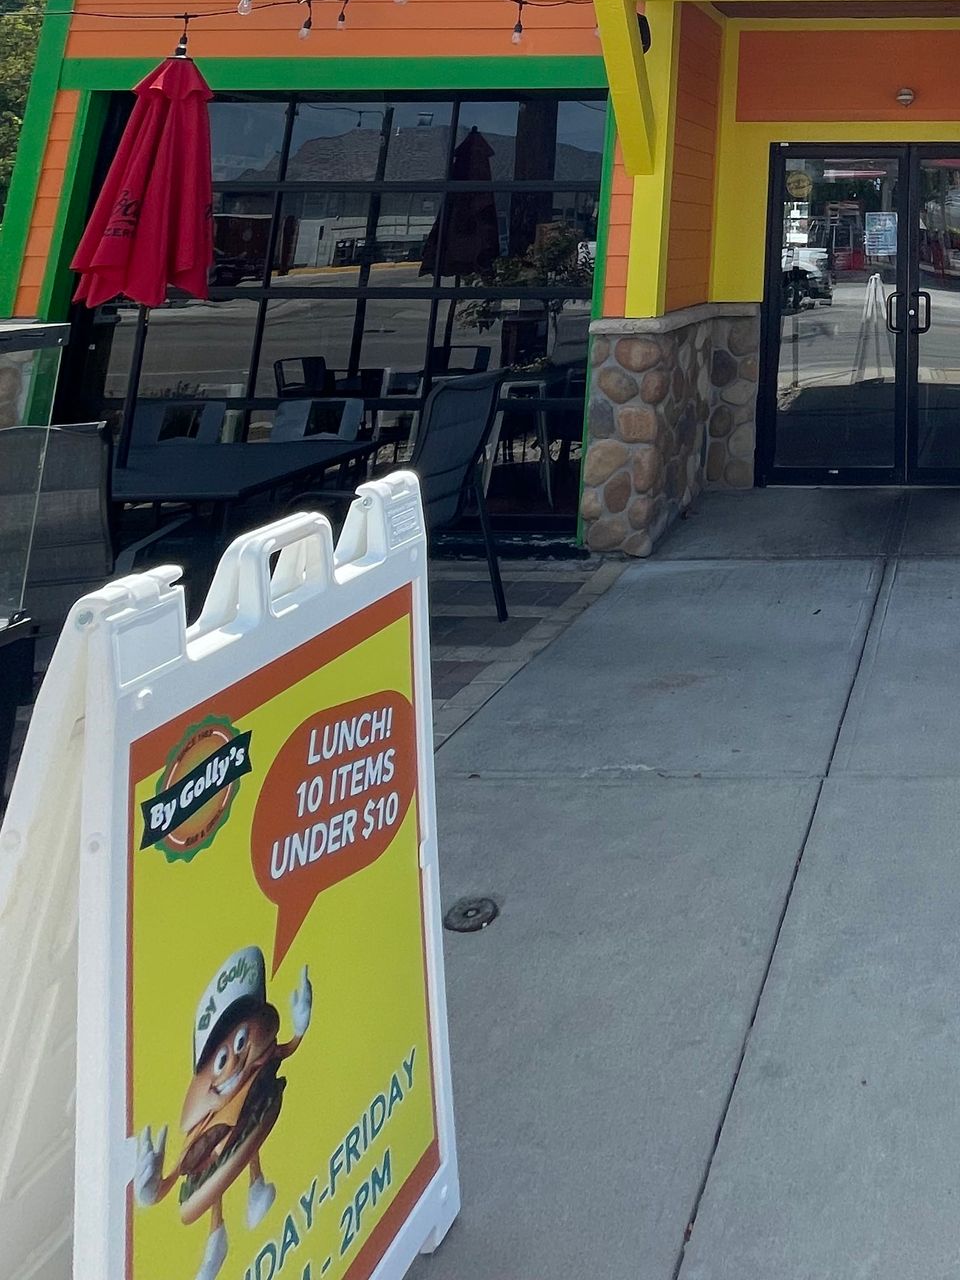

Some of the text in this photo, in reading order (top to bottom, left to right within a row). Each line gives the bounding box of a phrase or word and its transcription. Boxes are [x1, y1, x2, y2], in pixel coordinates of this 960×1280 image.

[307, 707, 393, 766] LUNCH!
[150, 798, 177, 832] By
[180, 746, 245, 809] Golly's
[296, 748, 396, 818] 10 ITEMS
[270, 809, 358, 880] UNDER
[361, 791, 399, 840] $10
[340, 1147, 392, 1255] 2PM
